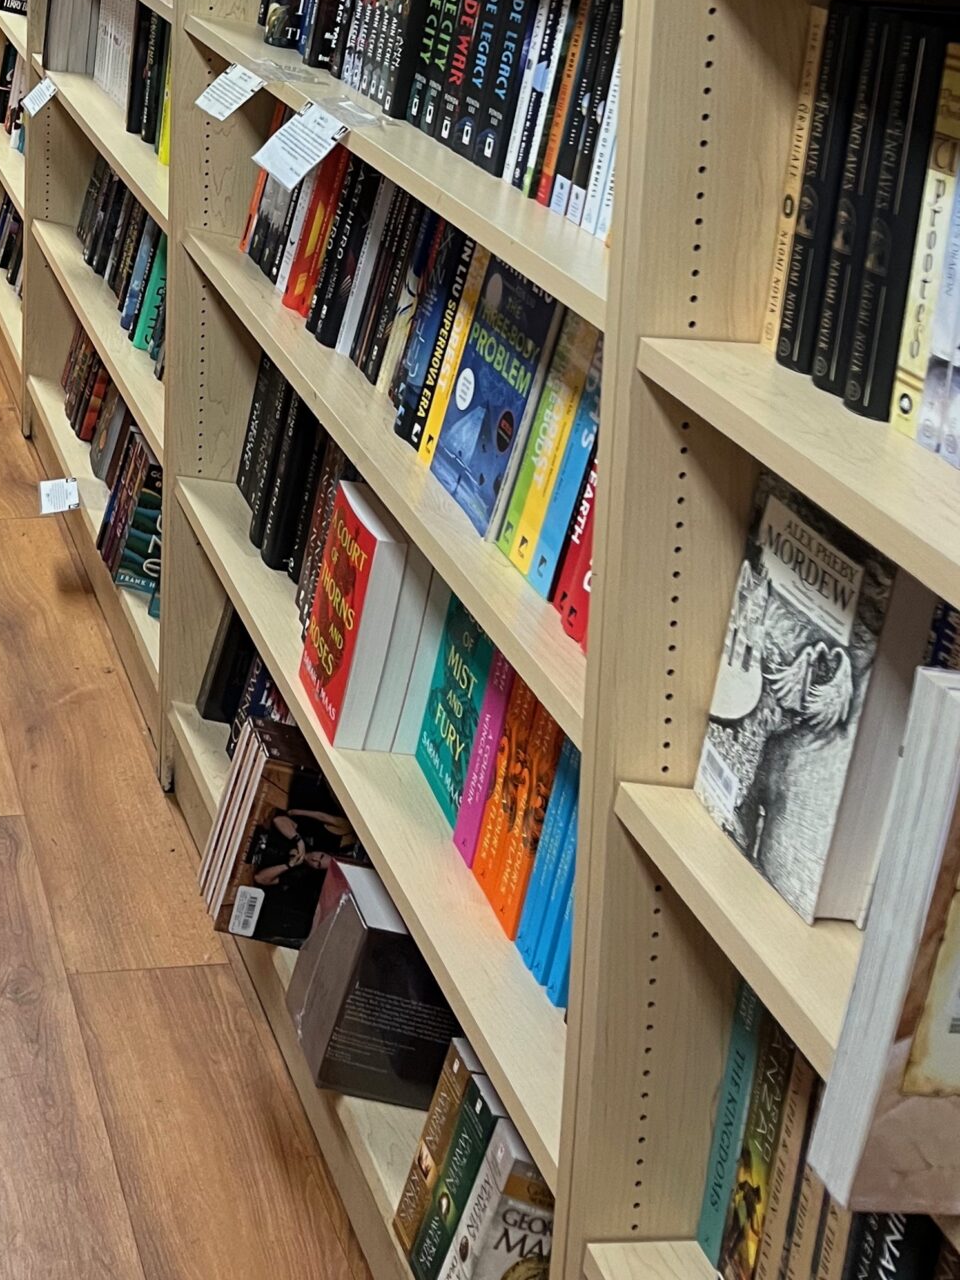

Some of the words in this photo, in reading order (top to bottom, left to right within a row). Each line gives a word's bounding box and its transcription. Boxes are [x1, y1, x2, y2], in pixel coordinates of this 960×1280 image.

[419, 14, 439, 66] CITY
[434, 20, 454, 72] CITY
[448, 35, 470, 87] WAR
[472, 23, 494, 90] LEGACY
[494, 31, 518, 101] LEGACY
[327, 202, 343, 251] HERO
[336, 209, 355, 260] HERO
[776, 229, 789, 271] NAOMI
[452, 265, 468, 299] LIU
[769, 272, 781, 317] NOVIK
[426, 299, 458, 388] SUPERNOVA
[468, 320, 533, 400] PROBLEM
[416, 390, 431, 419] ERA
[571, 470, 598, 545] EARTH
[330, 547, 340, 563] OF
[337, 521, 369, 572] COURT
[762, 523, 856, 613] MORDEW
[784, 519, 816, 552] ALEX
[814, 540, 861, 585] PHEBY
[120, 575, 147, 586] FRANK
[320, 562, 356, 631] THORNS
[309, 615, 334, 676] ROSES
[328, 622, 344, 650] AND
[447, 645, 478, 700] MIST
[446, 687, 464, 719] AND
[421, 730, 439, 765] SARAH
[434, 703, 467, 766] FURY
[479, 713, 492, 756] WINGS
[467, 772, 478, 805] RUIN
[710, 1095, 741, 1214] KINGDOMS
